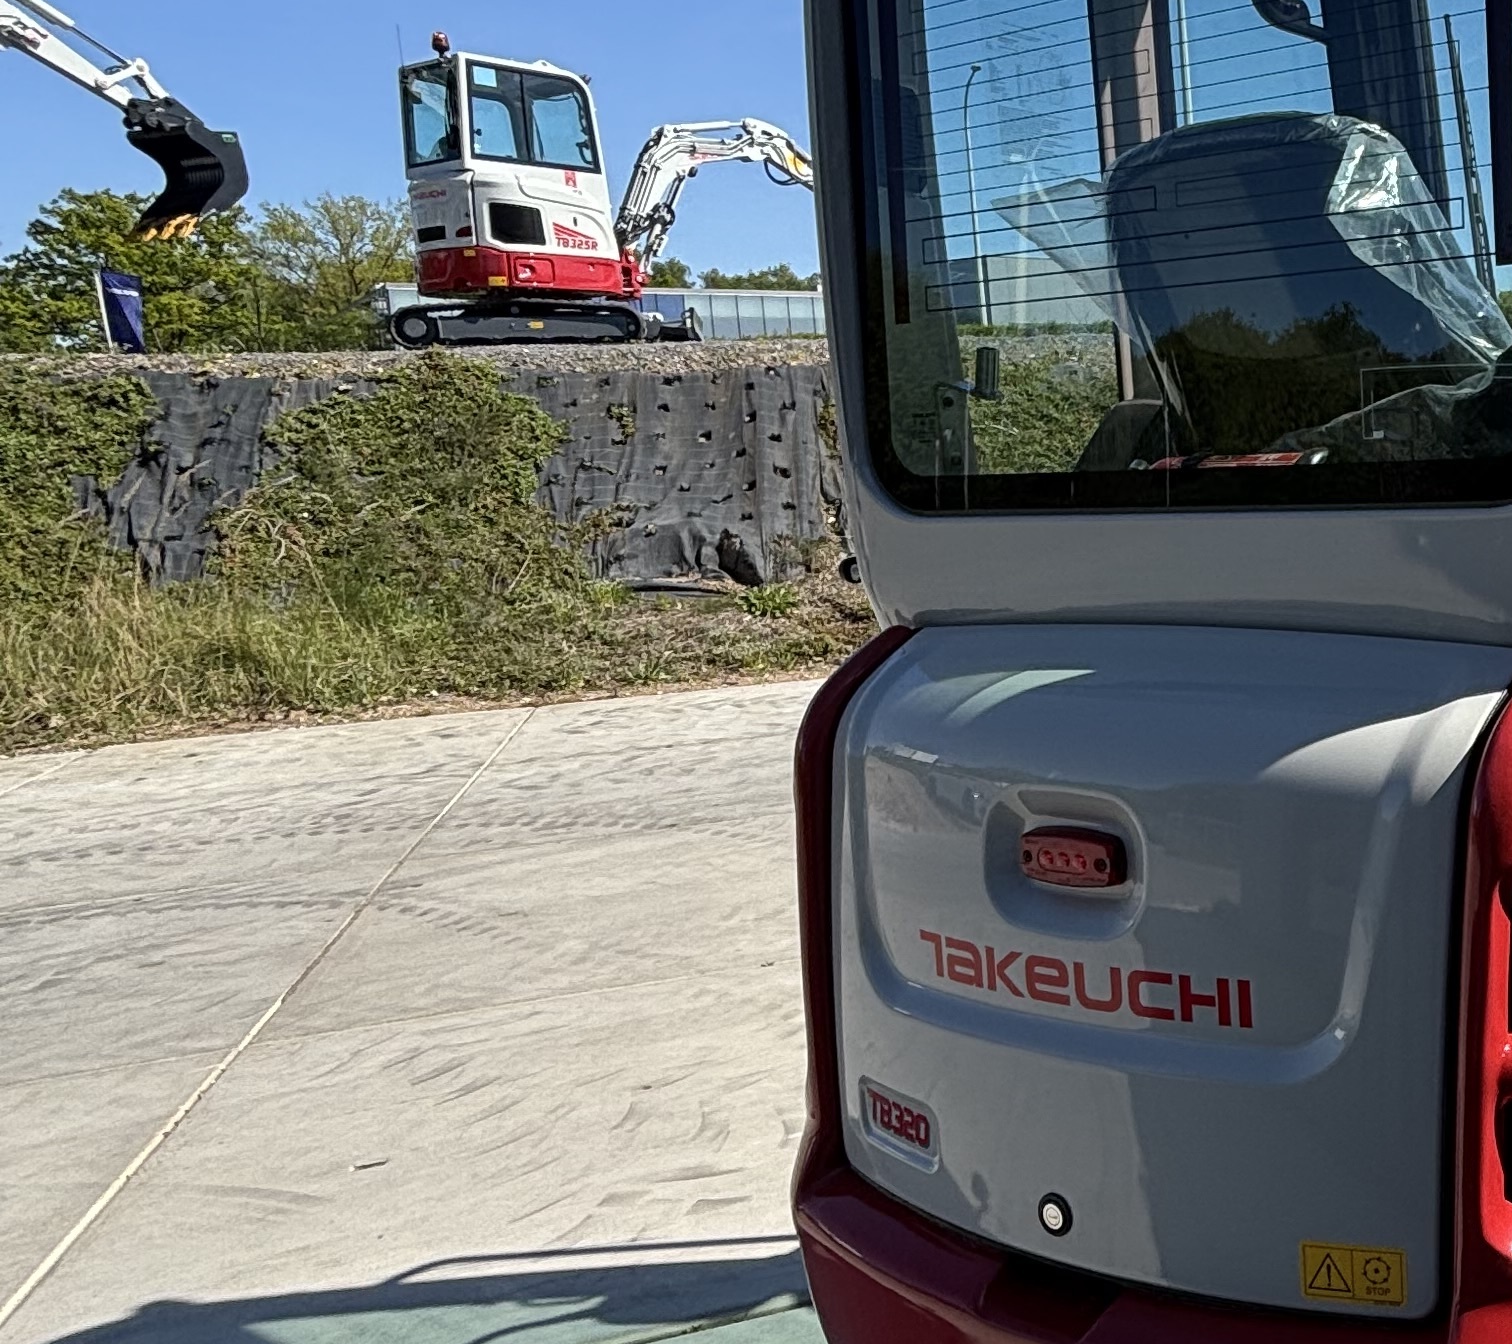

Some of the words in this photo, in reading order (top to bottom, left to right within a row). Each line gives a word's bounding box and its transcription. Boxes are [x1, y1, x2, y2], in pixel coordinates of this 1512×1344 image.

[555, 236, 598, 251] TB325R
[919, 929, 1253, 1028] TAKEUCHI
[866, 1087, 931, 1149] TB320
[1365, 1286, 1391, 1296] STOP
